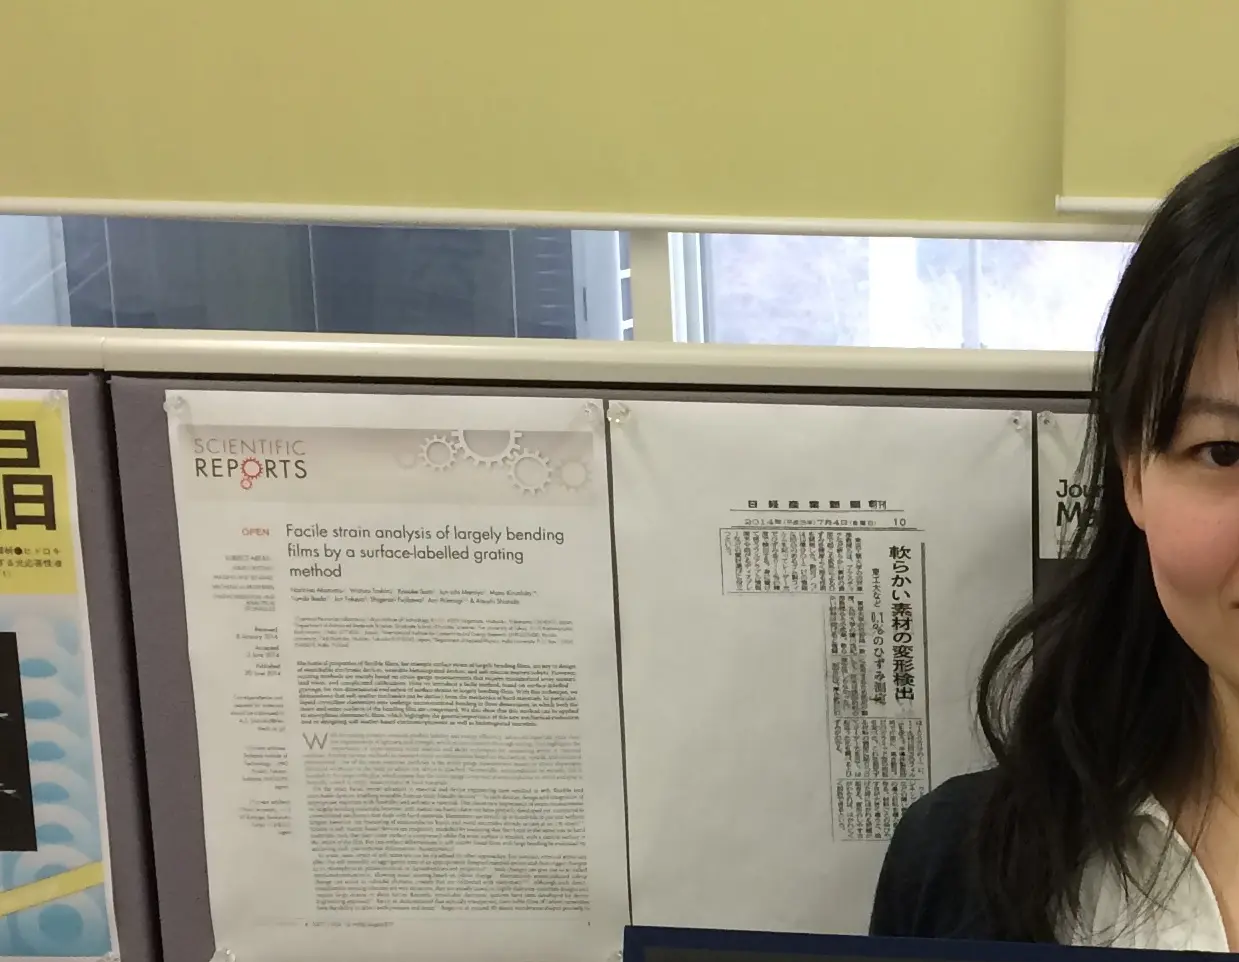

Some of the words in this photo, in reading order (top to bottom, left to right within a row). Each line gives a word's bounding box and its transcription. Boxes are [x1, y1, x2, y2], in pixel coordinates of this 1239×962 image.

[194, 438, 307, 457] SCIENTIFIC
[194, 457, 309, 482] REPORTS
[241, 528, 270, 537] OPEN
[893, 518, 907, 527] 10
[286, 524, 328, 539] Facile
[332, 524, 371, 539] strain
[375, 526, 432, 542] analysis
[435, 525, 450, 541] of
[454, 526, 502, 545] largely
[506, 526, 564, 545] bending
[287, 543, 321, 559] films
[324, 543, 342, 562] by
[345, 547, 356, 559] a
[359, 544, 470, 561] surface-labelled
[474, 546, 524, 564] grating
[289, 563, 342, 578] method
[888, 545, 916, 701] 軟らかい素材の変形検出
